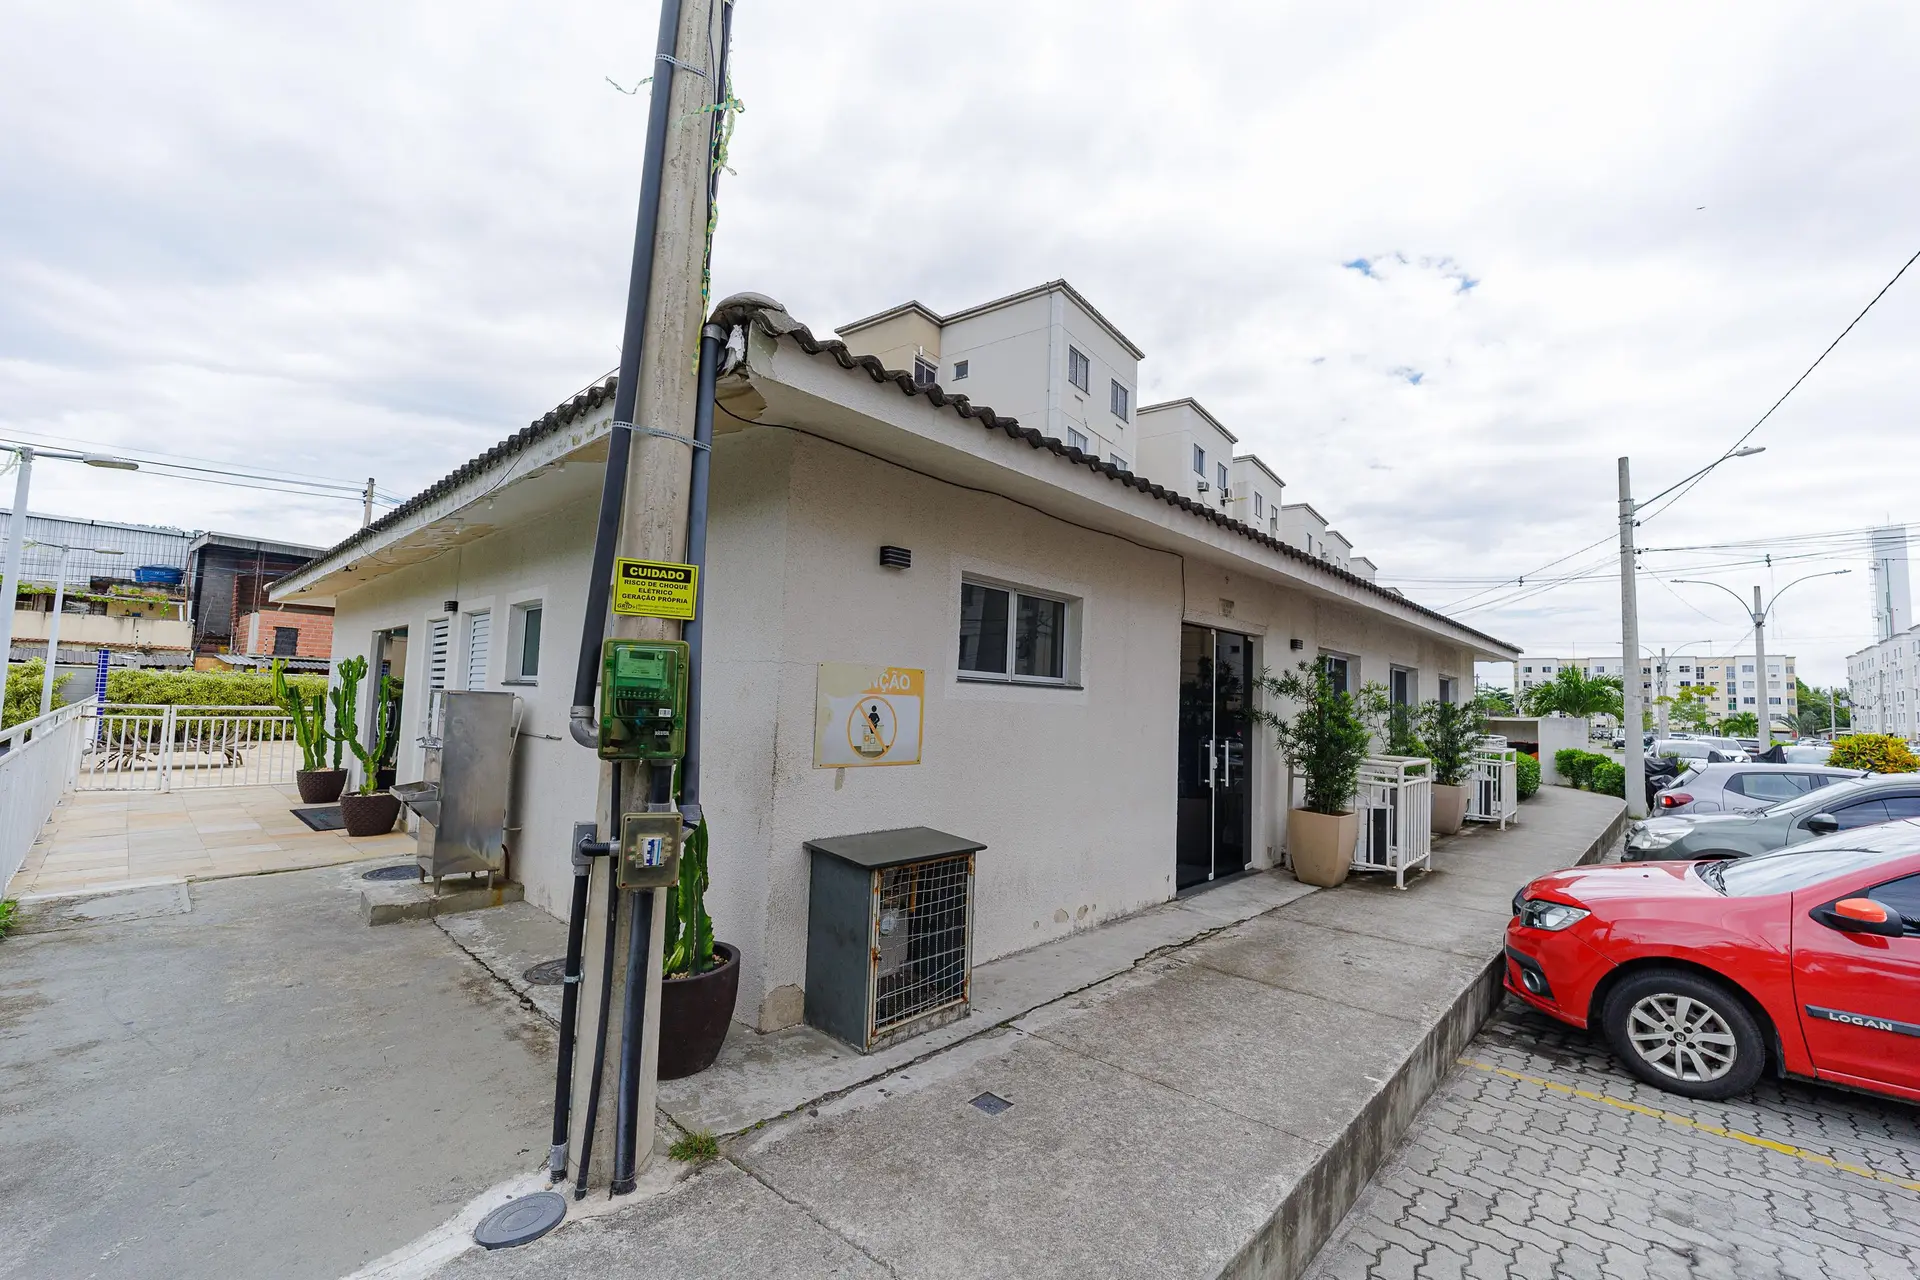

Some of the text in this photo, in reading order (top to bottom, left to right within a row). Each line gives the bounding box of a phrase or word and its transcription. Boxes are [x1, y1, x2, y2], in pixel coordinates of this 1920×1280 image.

[629, 566, 685, 580] CUIDADO
[624, 579, 646, 587] RISCO
[659, 582, 689, 590] CHOQUE
[638, 587, 673, 596] ELÉTRICO
[622, 593, 688, 604] GERAÇÃO PRÓPRIA
[1829, 1012, 1893, 1031] LOGAN
